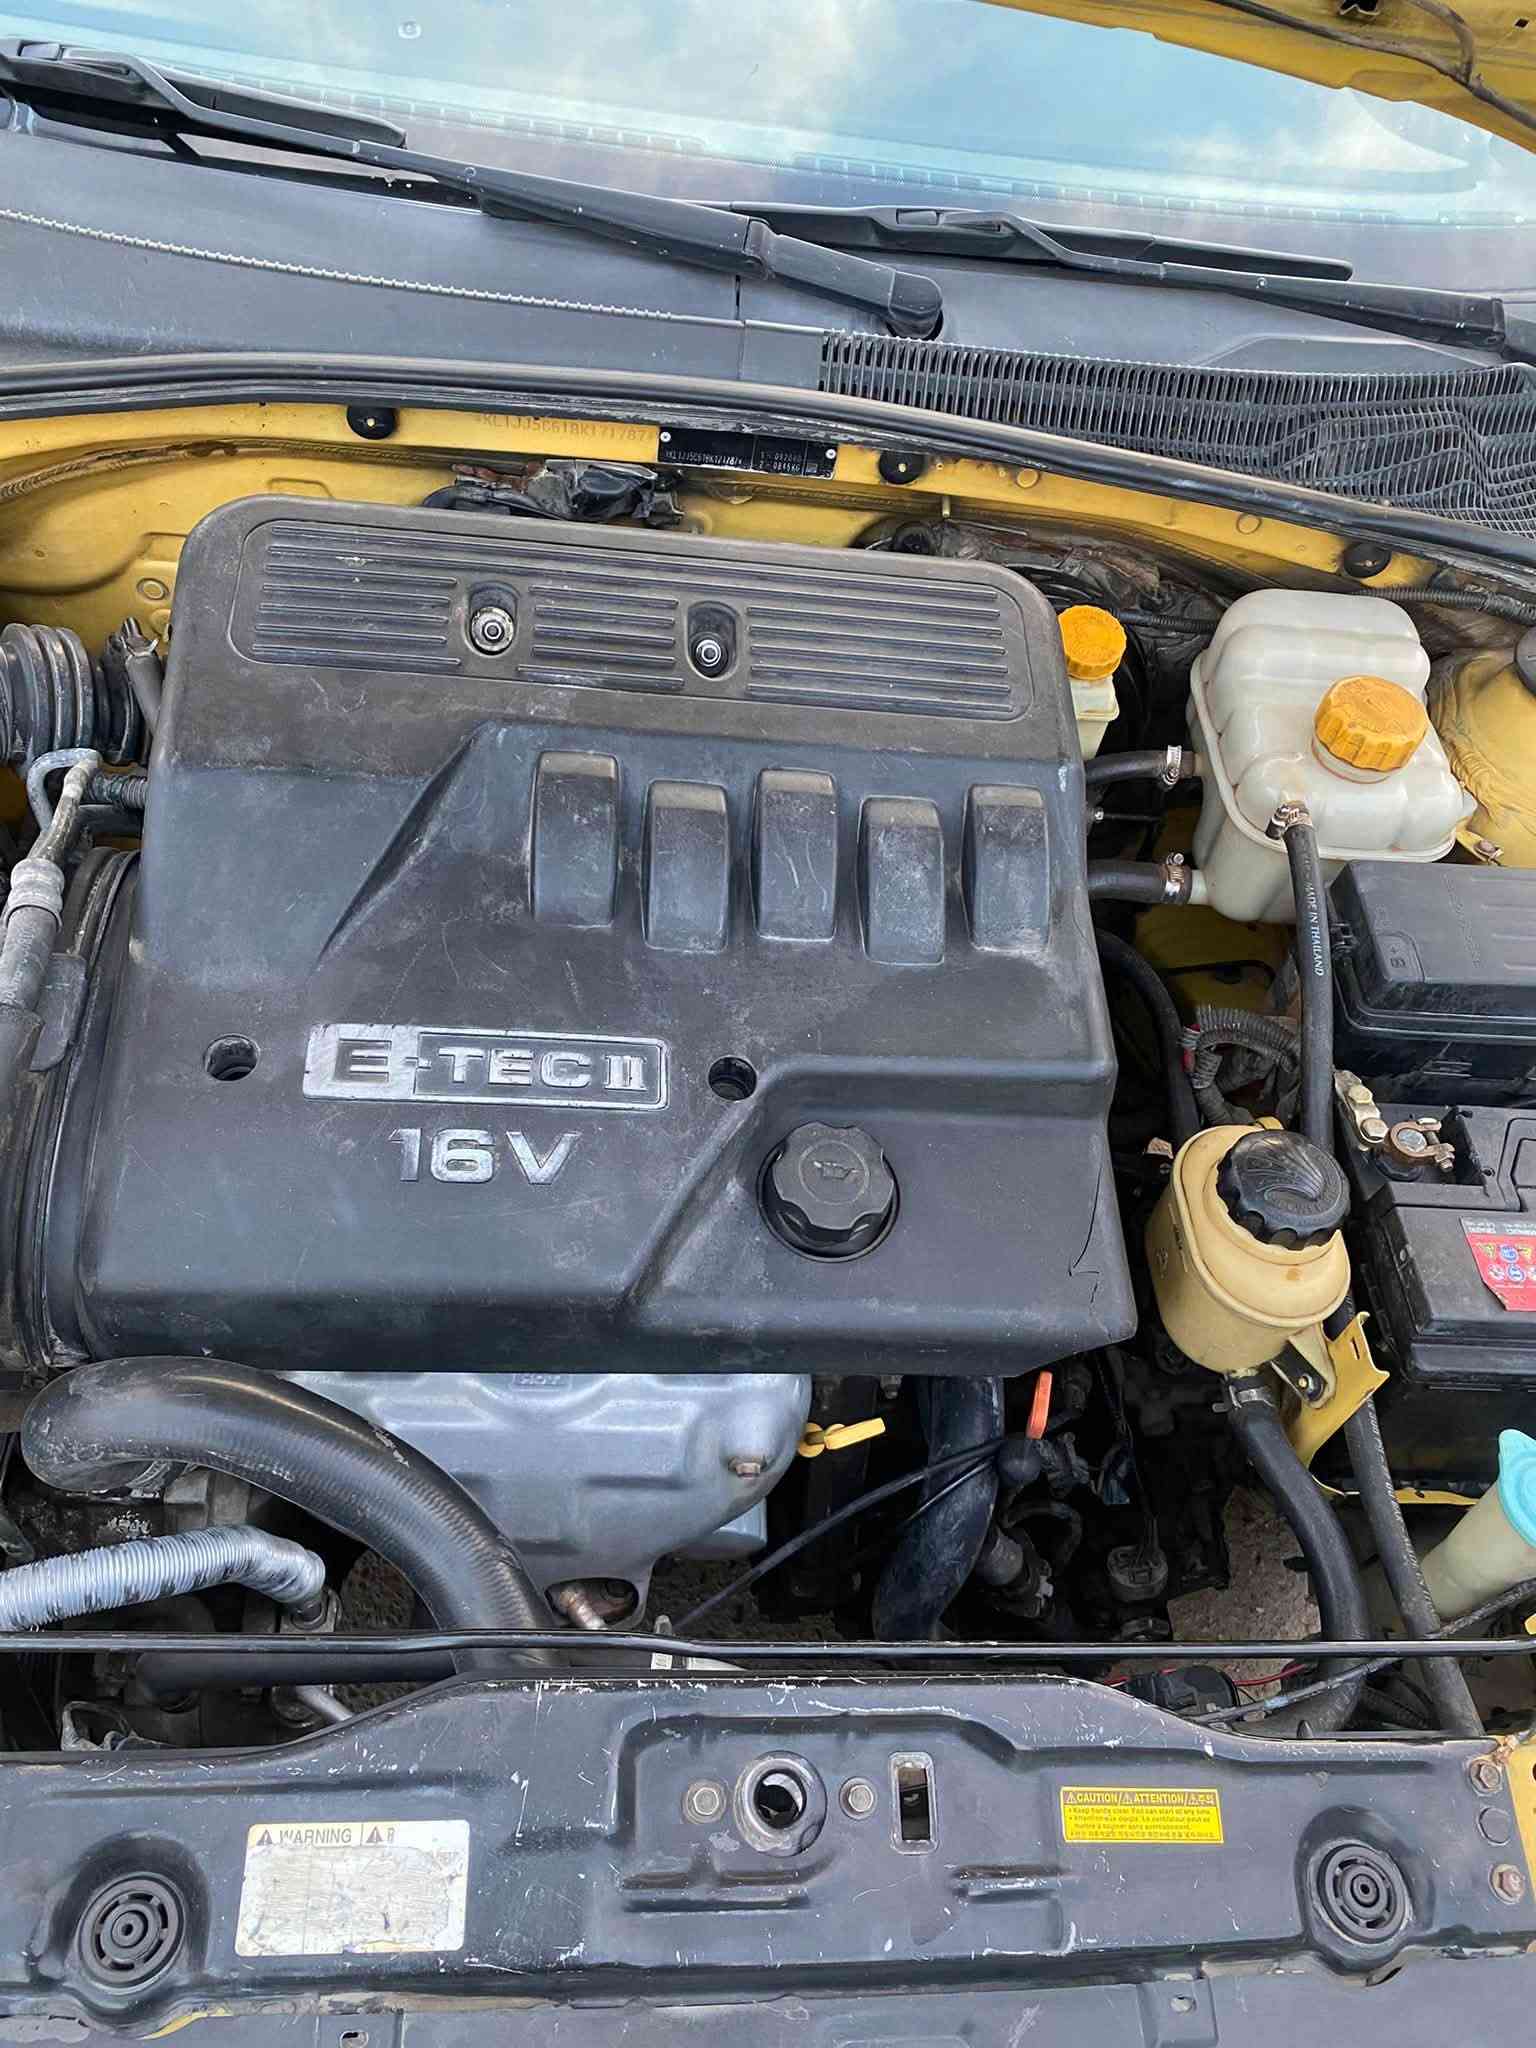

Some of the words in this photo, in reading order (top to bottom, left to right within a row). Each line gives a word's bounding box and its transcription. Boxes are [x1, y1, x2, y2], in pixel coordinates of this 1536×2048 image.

[1310, 926, 1325, 976] THAILAND
[1076, 1792, 1118, 1804] CAUTION
[1135, 1793, 1184, 1806] ATTENTION
[279, 1828, 352, 1844] WARNING
